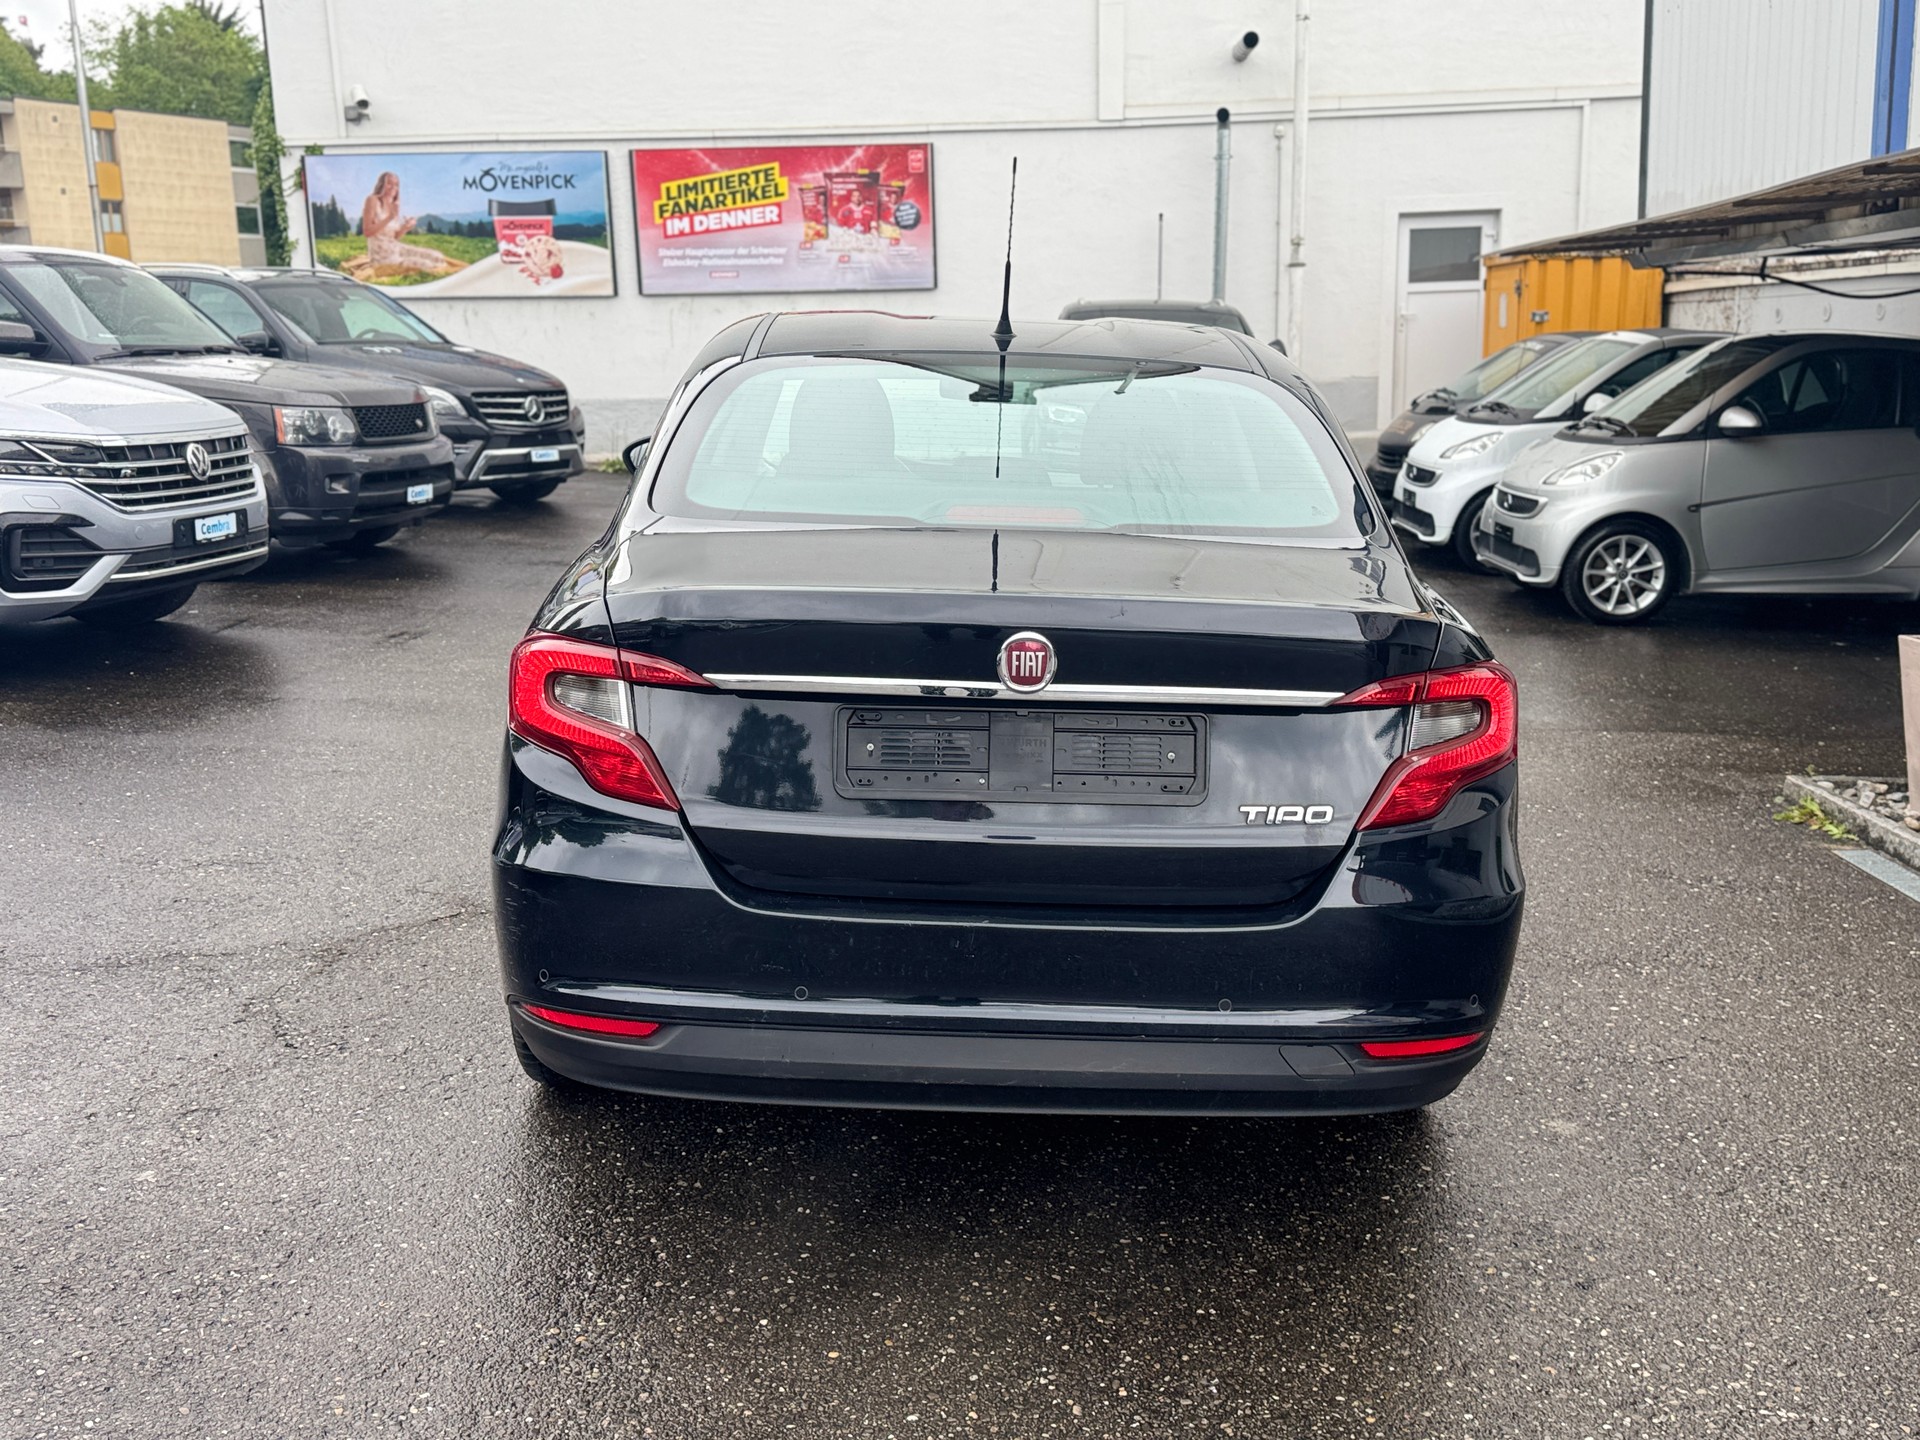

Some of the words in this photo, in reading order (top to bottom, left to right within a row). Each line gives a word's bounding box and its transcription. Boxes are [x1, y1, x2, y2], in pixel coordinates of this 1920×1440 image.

[665, 166, 776, 201] LIMITIERTE
[658, 182, 785, 219] FANARTIKEL
[665, 215, 691, 236] IM
[693, 205, 780, 232] DENNER
[201, 520, 230, 535] Cembra
[1011, 651, 1045, 677] FIAT
[1239, 805, 1334, 825] TIPO
